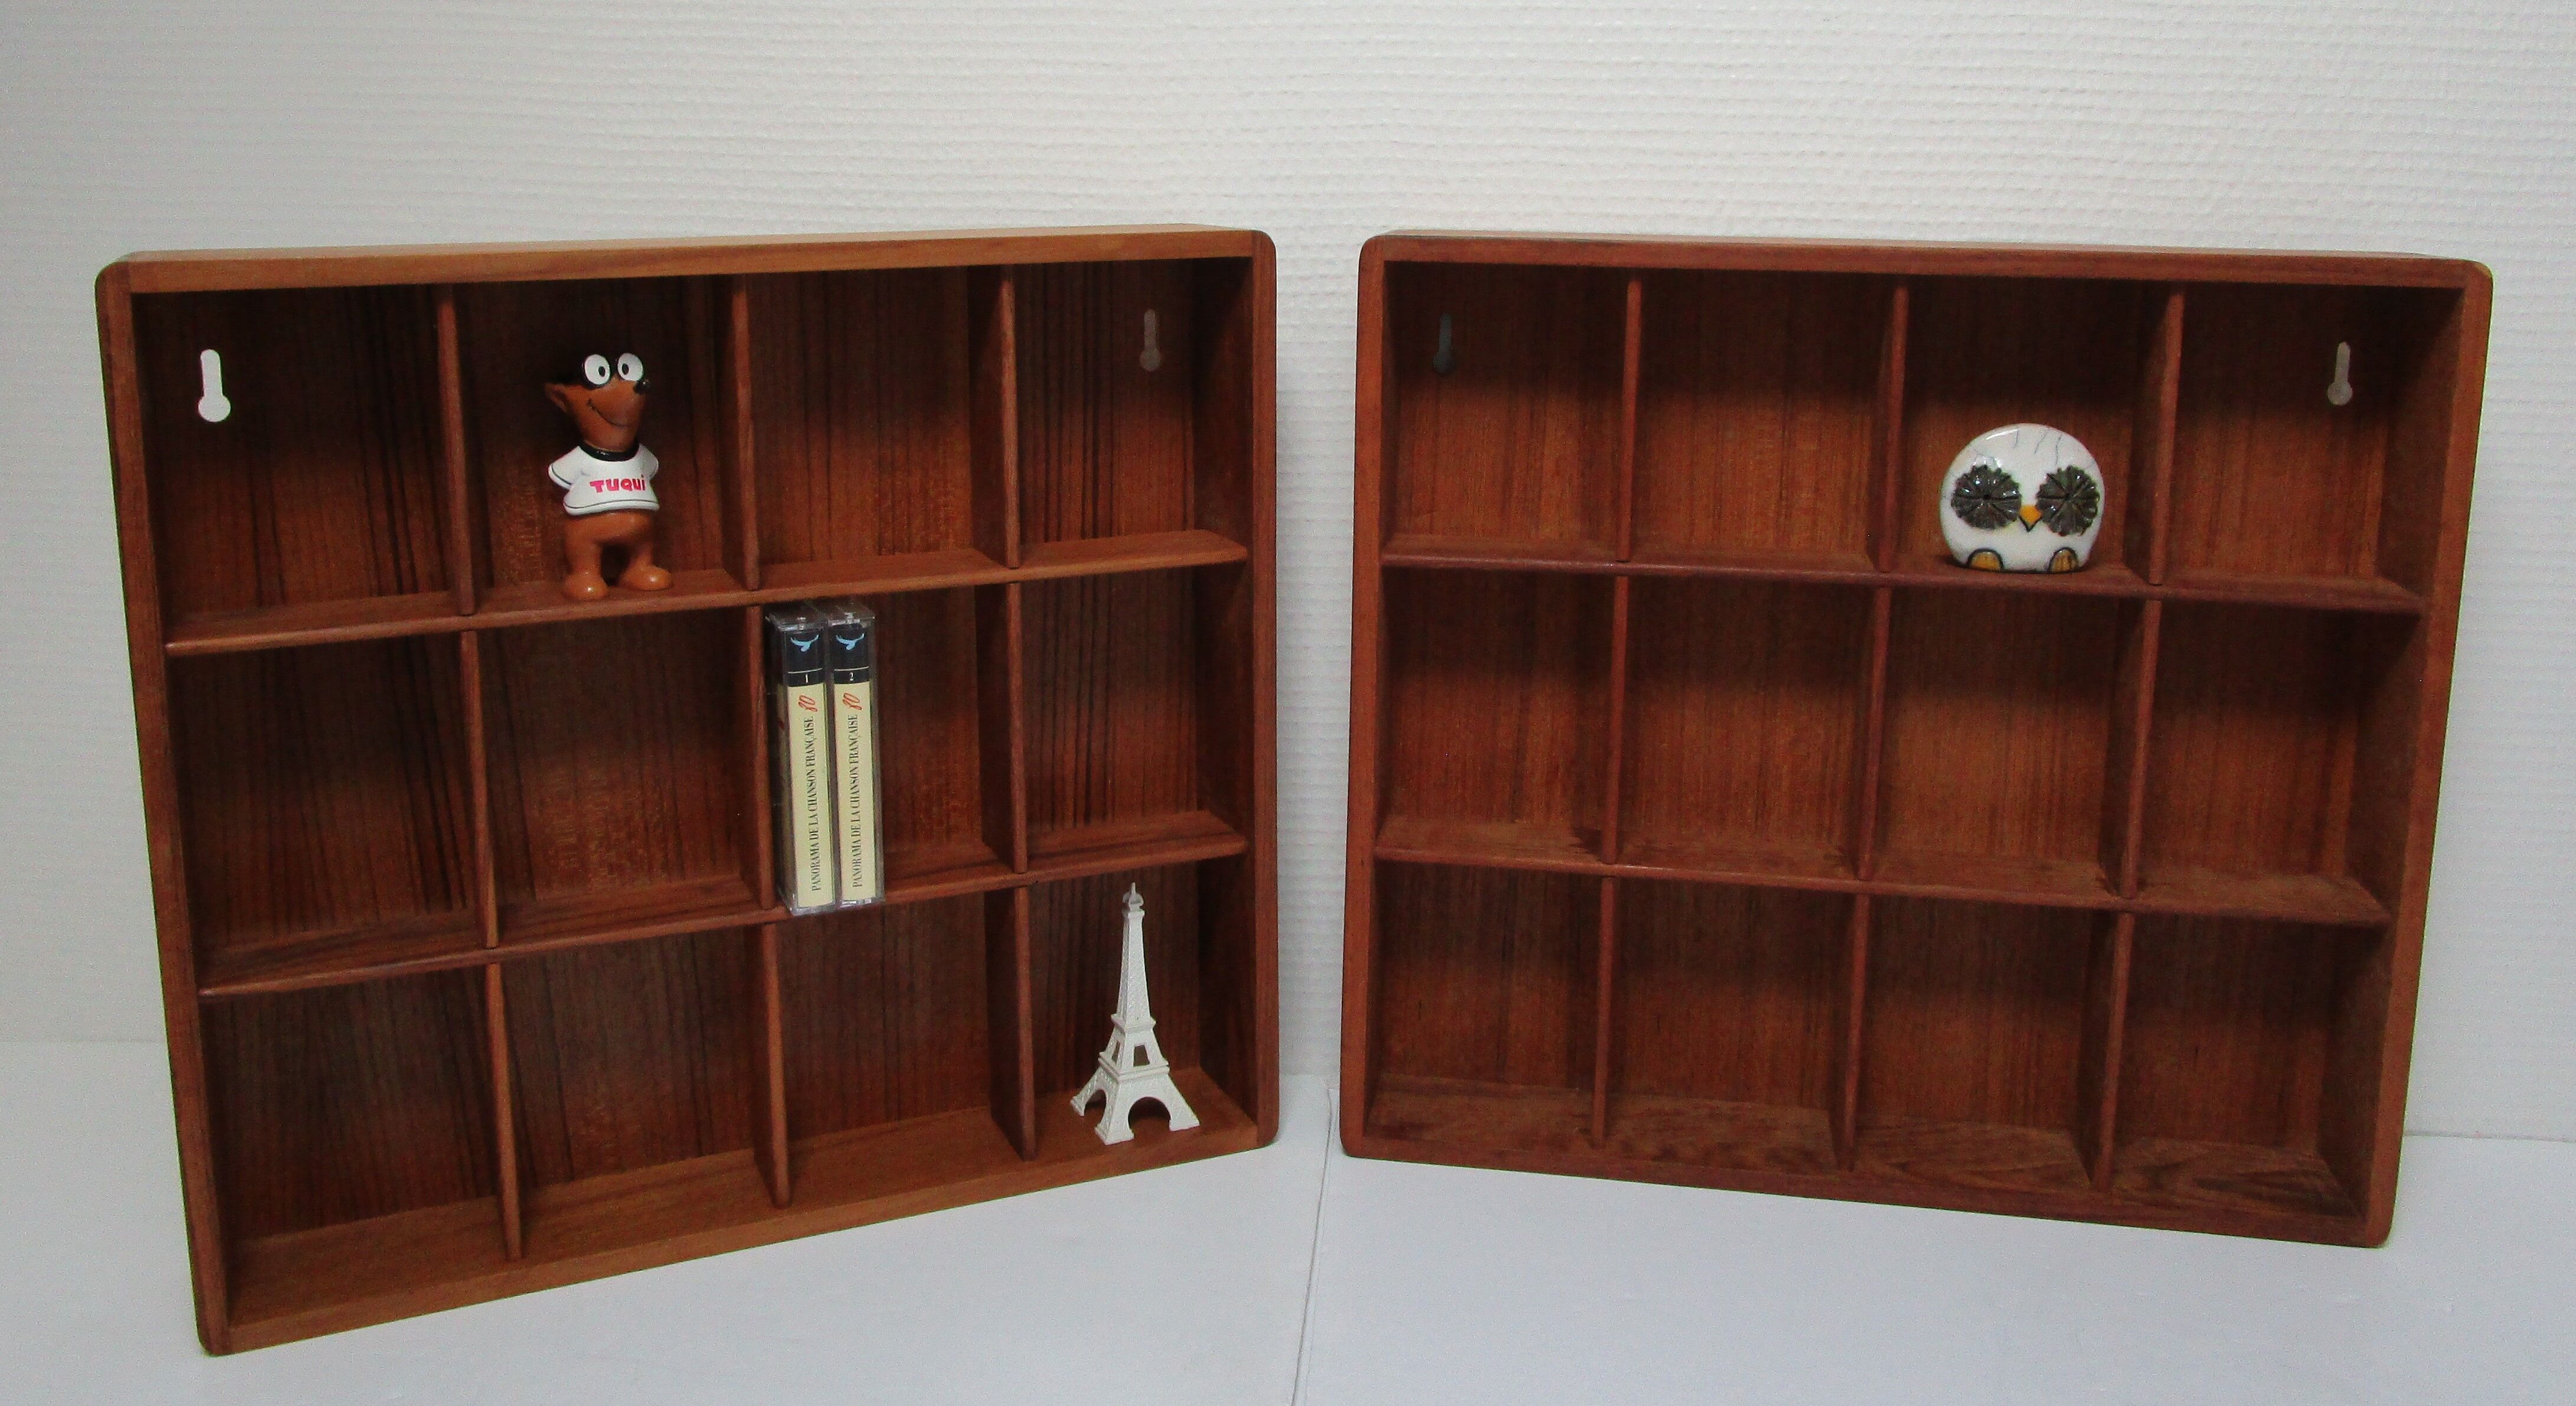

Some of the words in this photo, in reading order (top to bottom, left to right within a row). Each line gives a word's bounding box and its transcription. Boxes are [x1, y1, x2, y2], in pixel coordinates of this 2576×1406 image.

[805, 674, 808, 683] 1
[849, 672, 854, 681] 2
[804, 716, 817, 767] FRANÇAISE
[848, 714, 860, 764] FRANÇAISE
[807, 769, 818, 812] CHANSON
[850, 766, 860, 809] CHANSON
[808, 813, 818, 826] LA
[850, 811, 860, 822] LA
[851, 824, 861, 837] DE
[809, 827, 819, 840] DE
[811, 842, 821, 891] PANORAMA
[852, 839, 862, 887] PANORAMA
